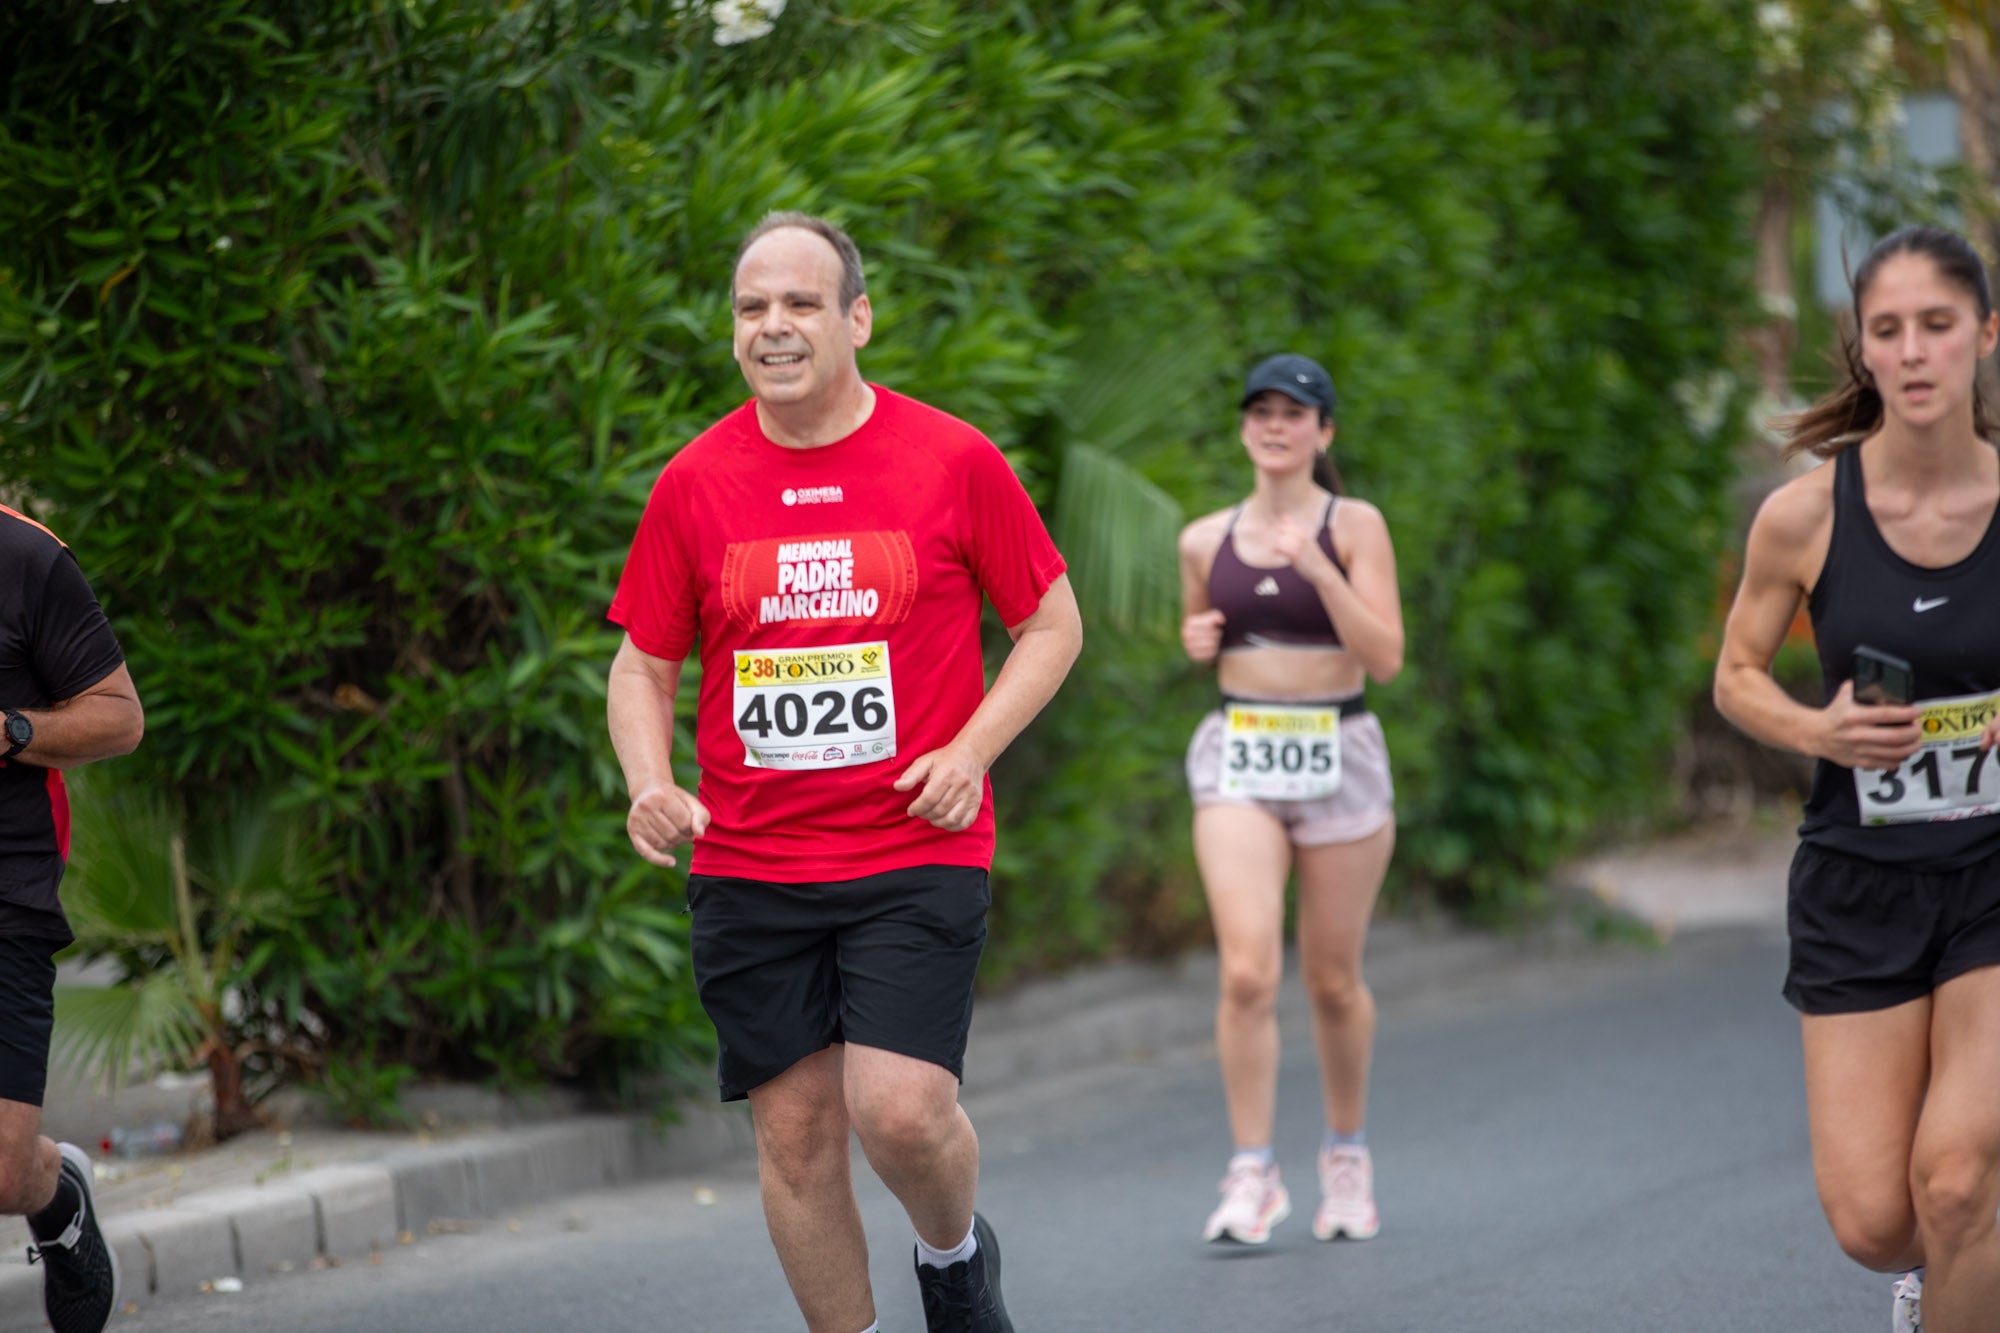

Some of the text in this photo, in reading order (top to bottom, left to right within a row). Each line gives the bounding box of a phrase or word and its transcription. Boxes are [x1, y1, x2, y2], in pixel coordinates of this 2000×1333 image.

[776, 539, 853, 563] MEMORIAL
[777, 558, 854, 595] PADRE
[759, 588, 879, 624] MARCELINO
[752, 657, 855, 679] 38 FONDO
[778, 655, 805, 664] GRAN
[807, 652, 846, 663] PREMIO
[738, 686, 889, 739] 4026
[1922, 709, 1998, 735] ONDO
[1229, 739, 1332, 774] 3305
[1867, 745, 2000, 805] 317
